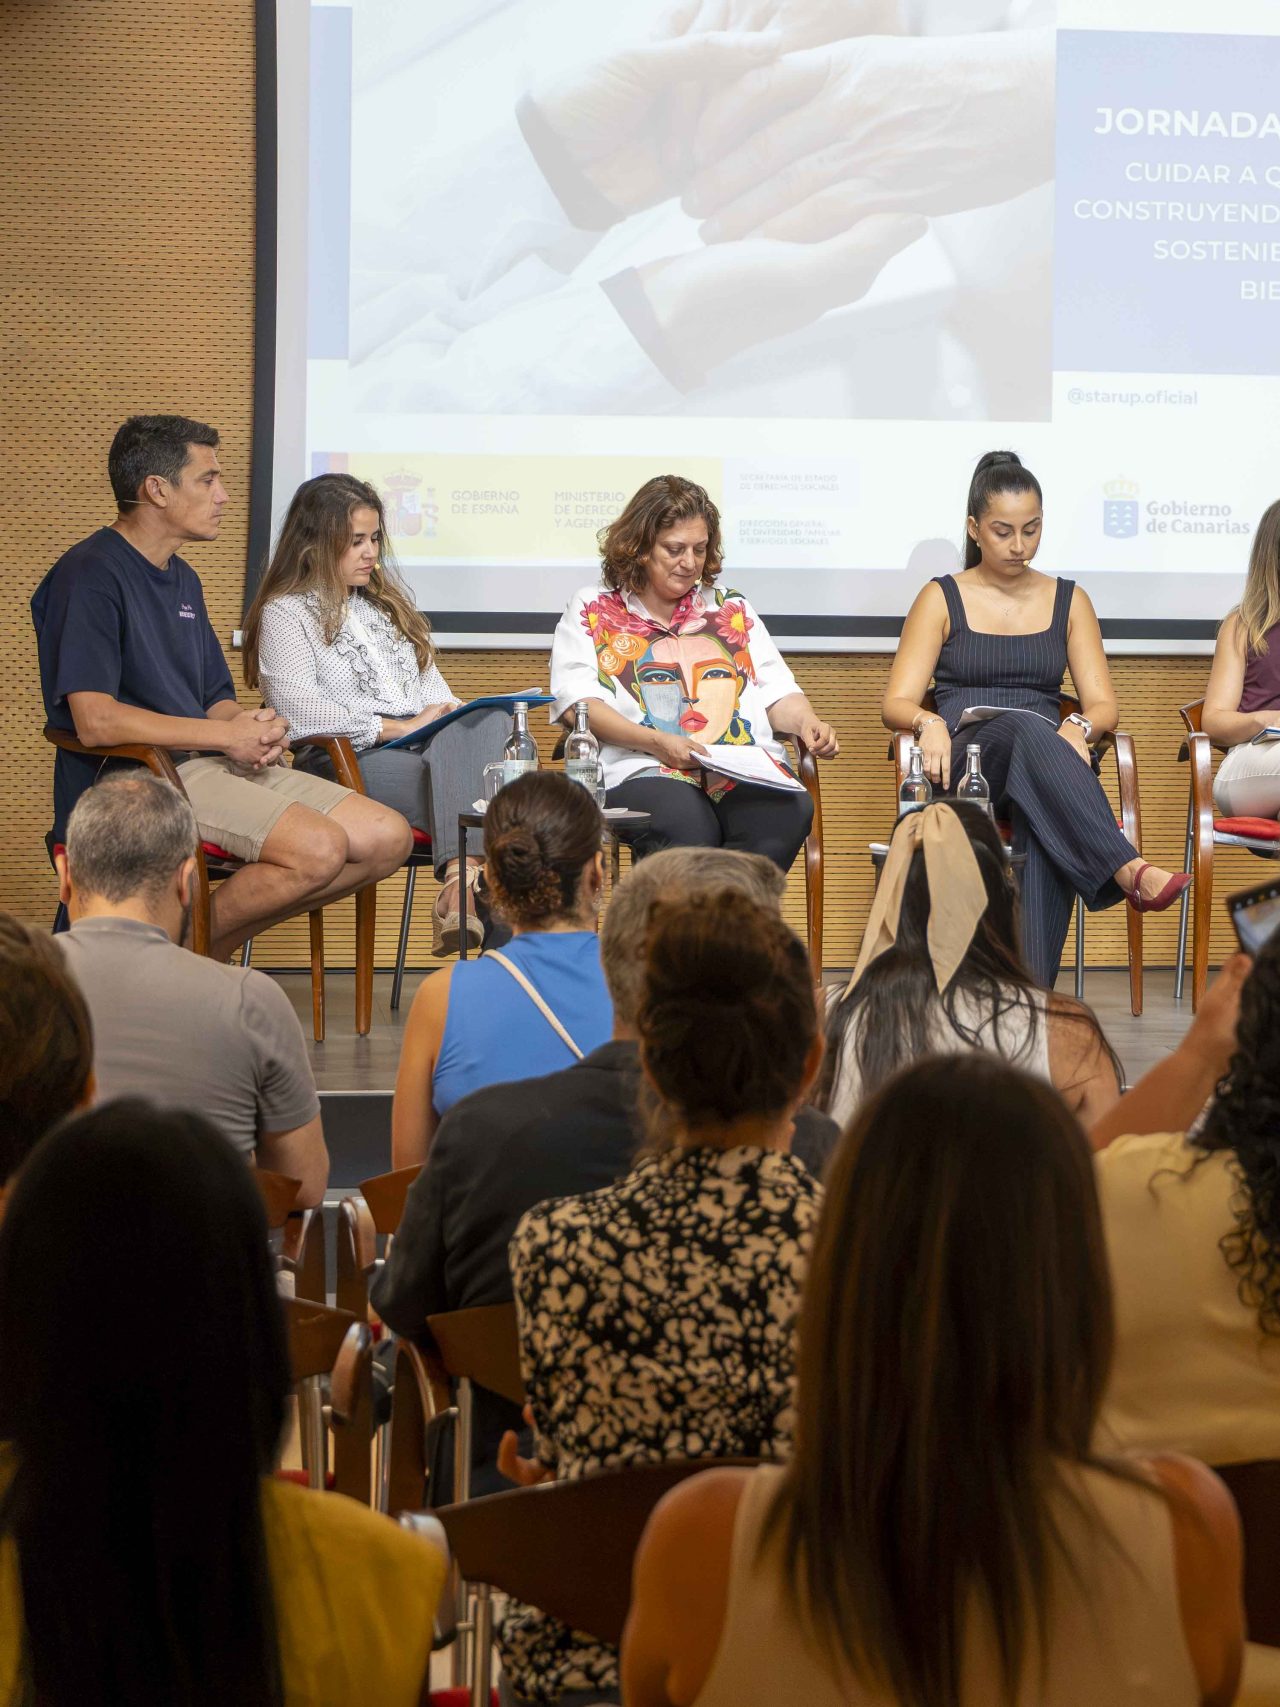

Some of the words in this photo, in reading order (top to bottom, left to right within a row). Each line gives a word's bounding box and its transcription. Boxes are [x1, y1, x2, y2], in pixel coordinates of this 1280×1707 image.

[1125, 162, 1230, 183] CUIDAR
[1238, 165, 1257, 184] A
[1067, 387, 1197, 406] @starup.oficial
[451, 489, 519, 500] GOBIERNO
[554, 491, 626, 501] MINISTERIO
[451, 503, 467, 513] DE
[471, 502, 519, 514] ESPAÑA
[554, 504, 570, 514] DE
[574, 504, 621, 516] DERECH
[1145, 500, 1231, 516] Gobierno
[554, 518, 561, 528] Y
[1145, 518, 1167, 533] de
[1170, 518, 1250, 534] Canarias
